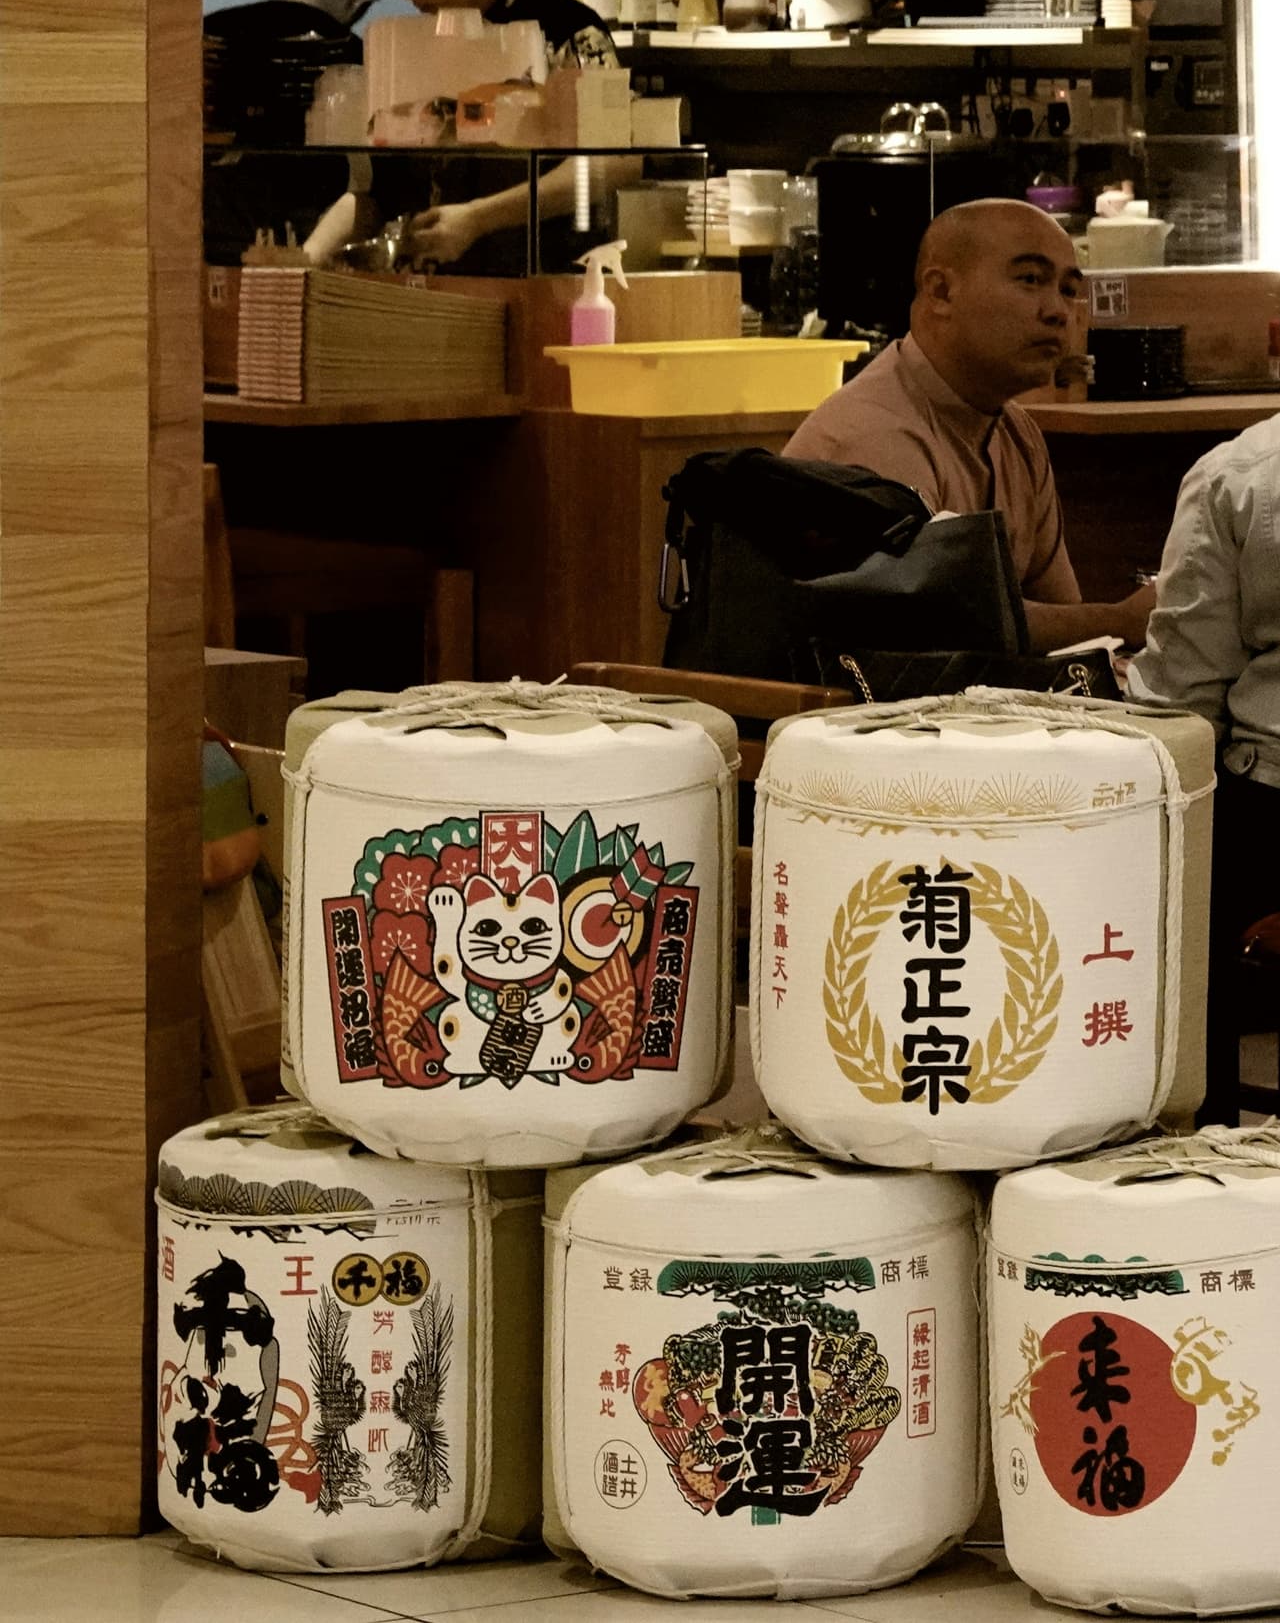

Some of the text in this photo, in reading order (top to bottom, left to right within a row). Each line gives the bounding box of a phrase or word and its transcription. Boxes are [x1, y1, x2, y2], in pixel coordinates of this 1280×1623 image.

[898, 864, 974, 1115] 菊正宗
[1082, 923, 1135, 1047] 上撰
[280, 1256, 318, 1297] 王
[880, 1255, 929, 1285] 商標
[1200, 1268, 1256, 1294] 商標
[715, 1324, 831, 1517] 開運
